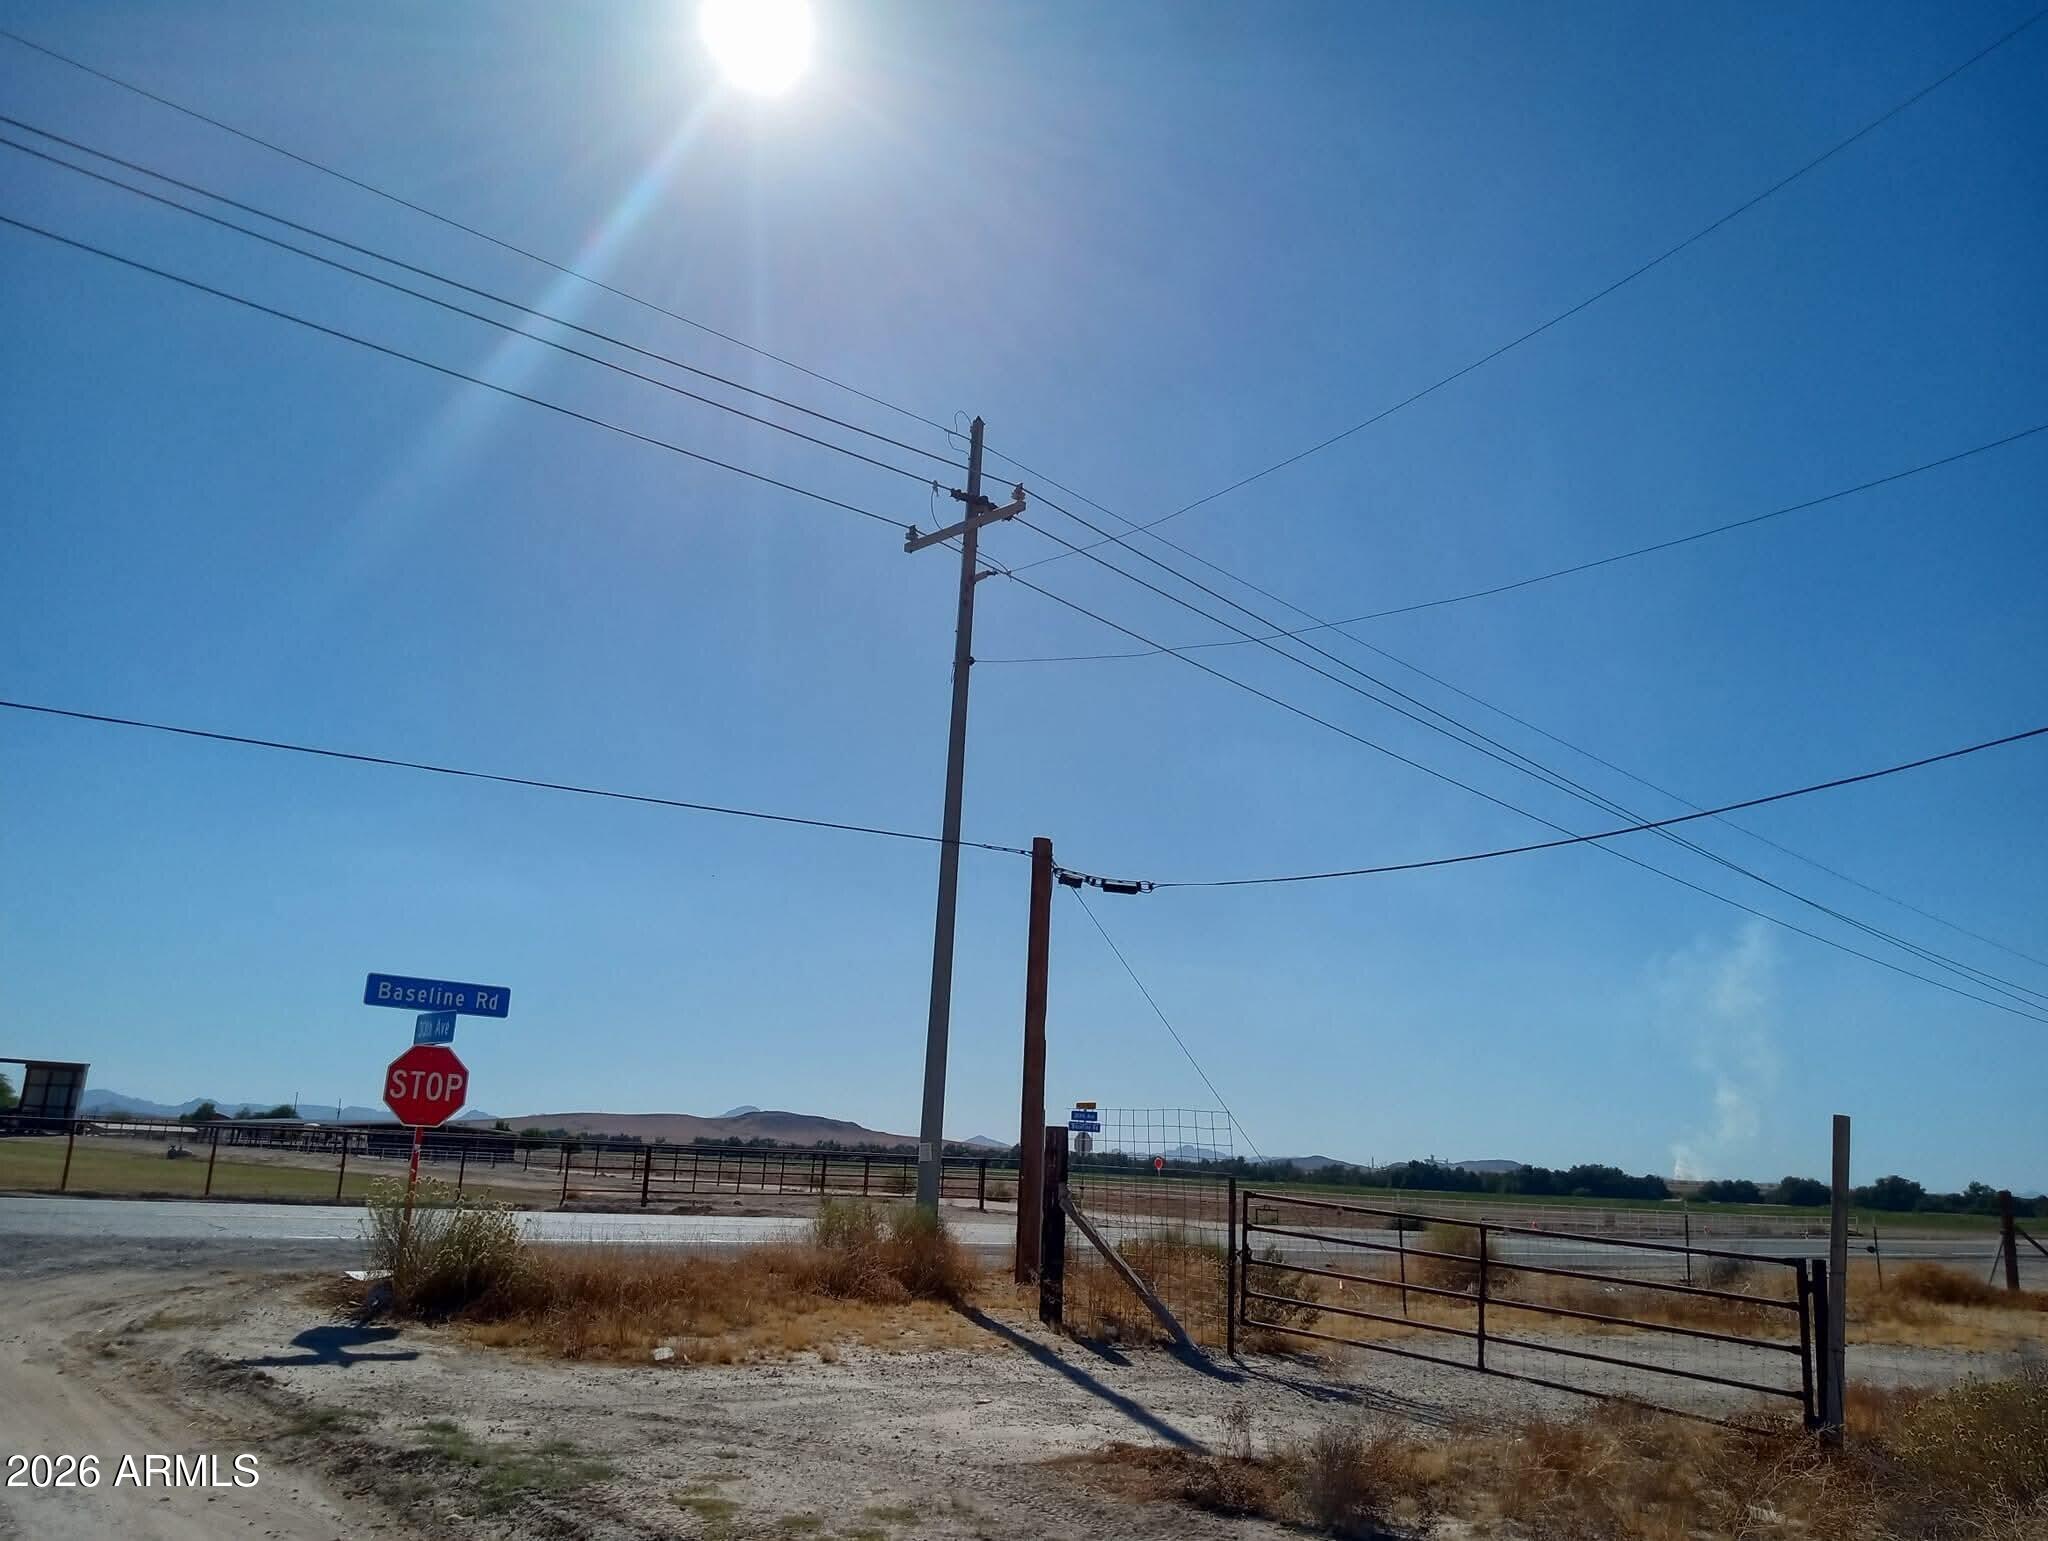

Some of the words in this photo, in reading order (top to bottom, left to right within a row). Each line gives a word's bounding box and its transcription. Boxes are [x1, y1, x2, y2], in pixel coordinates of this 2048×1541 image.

[378, 982, 465, 1007] Baseline
[475, 992, 499, 1010] Rd
[389, 1069, 464, 1102] STOP
